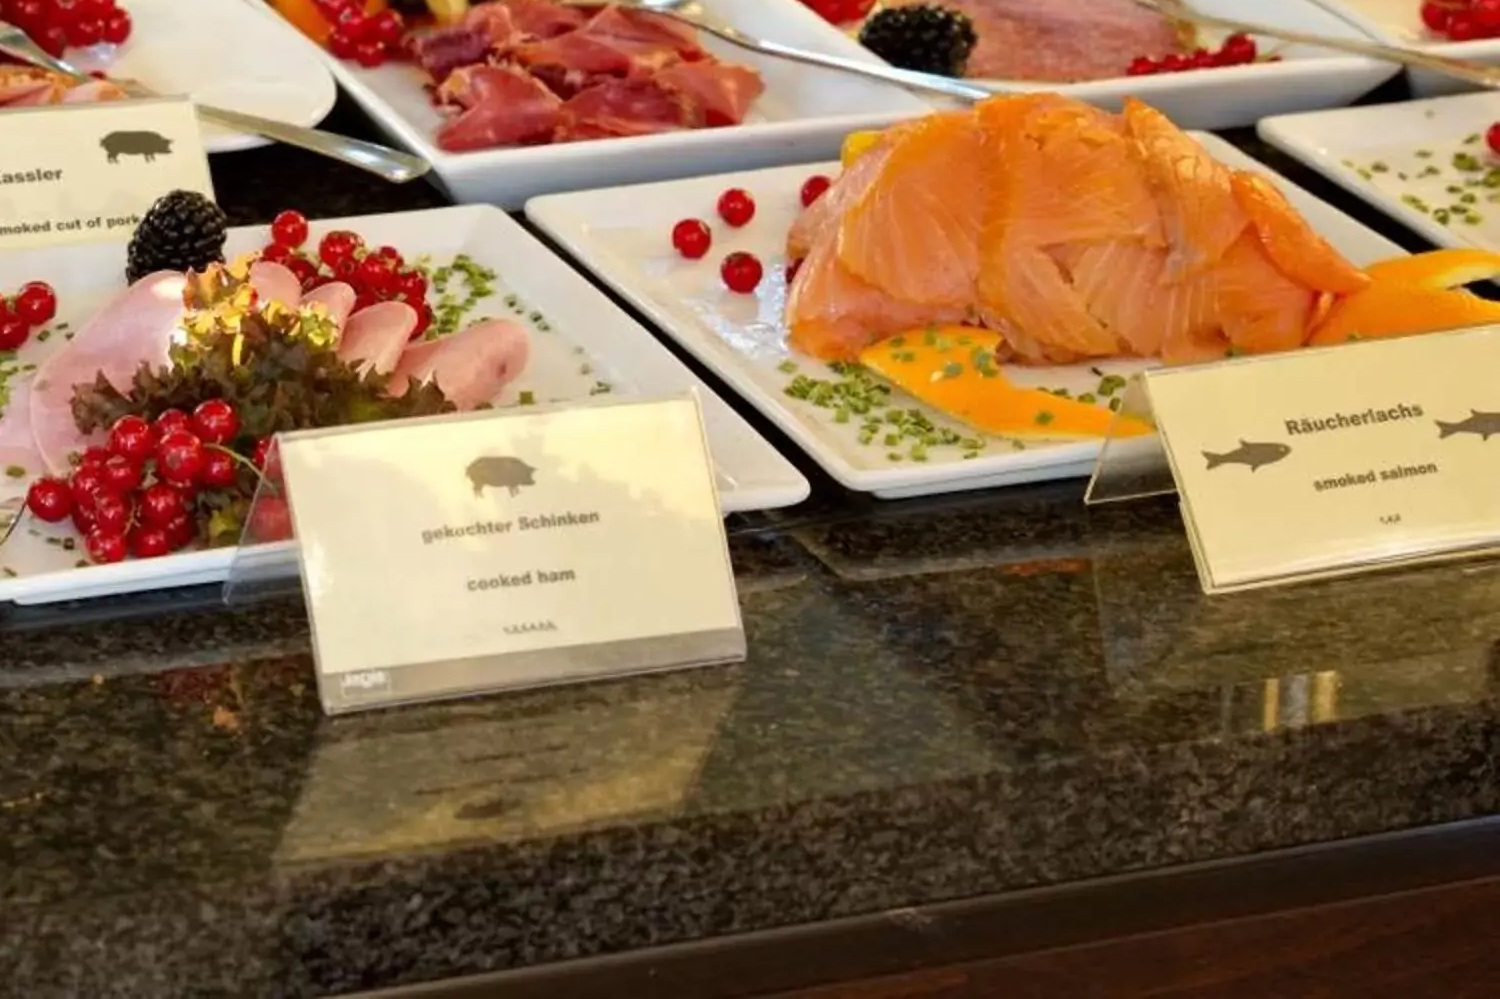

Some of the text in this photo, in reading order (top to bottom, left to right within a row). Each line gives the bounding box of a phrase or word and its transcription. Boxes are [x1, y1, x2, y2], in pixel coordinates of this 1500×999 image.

[55, 218, 82, 232] cut
[86, 216, 102, 229] of
[106, 214, 141, 231] pork
[1284, 403, 1424, 436] Räucherlachs
[1313, 463, 1439, 492] smoked salmon
[517, 511, 600, 531] Schinken
[466, 569, 576, 592] cooked ham
